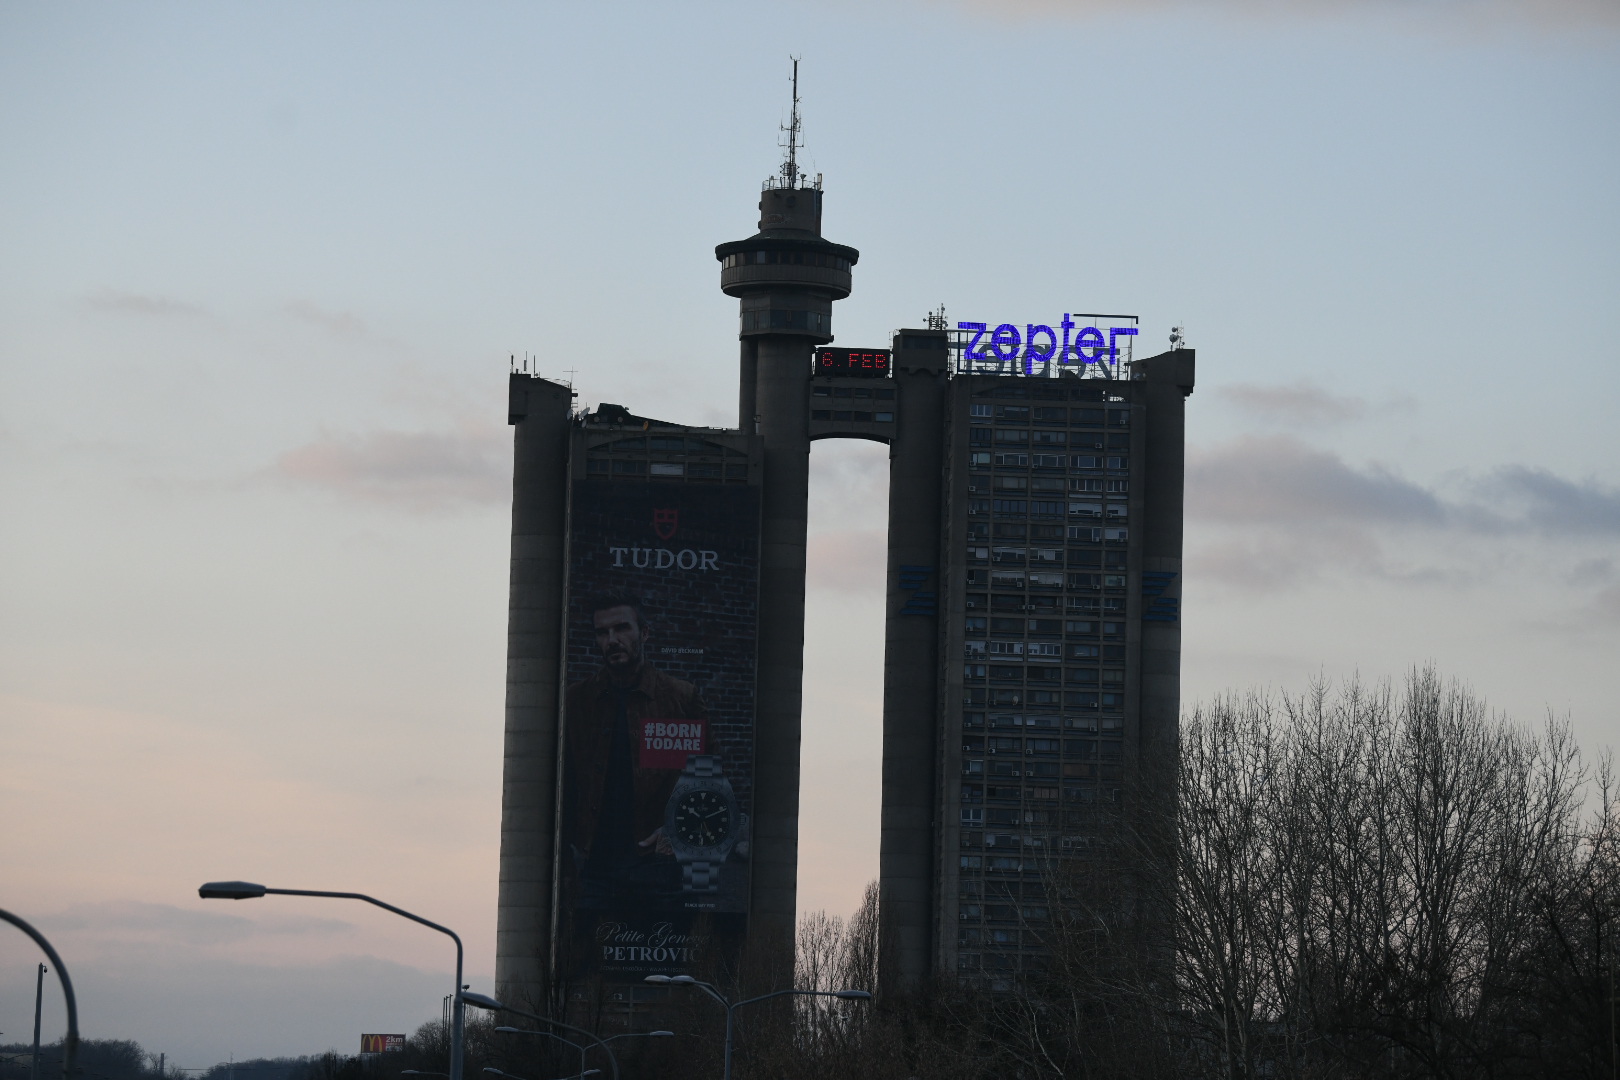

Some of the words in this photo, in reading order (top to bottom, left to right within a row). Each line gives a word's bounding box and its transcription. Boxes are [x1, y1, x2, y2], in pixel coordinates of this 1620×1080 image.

[958, 313, 1138, 375] zepter
[848, 353, 887, 369] FEB
[609, 546, 720, 571] TUDOR
[645, 723, 702, 738] #BORN
[645, 738, 701, 751] TODARE
[596, 921, 645, 943] Petite
